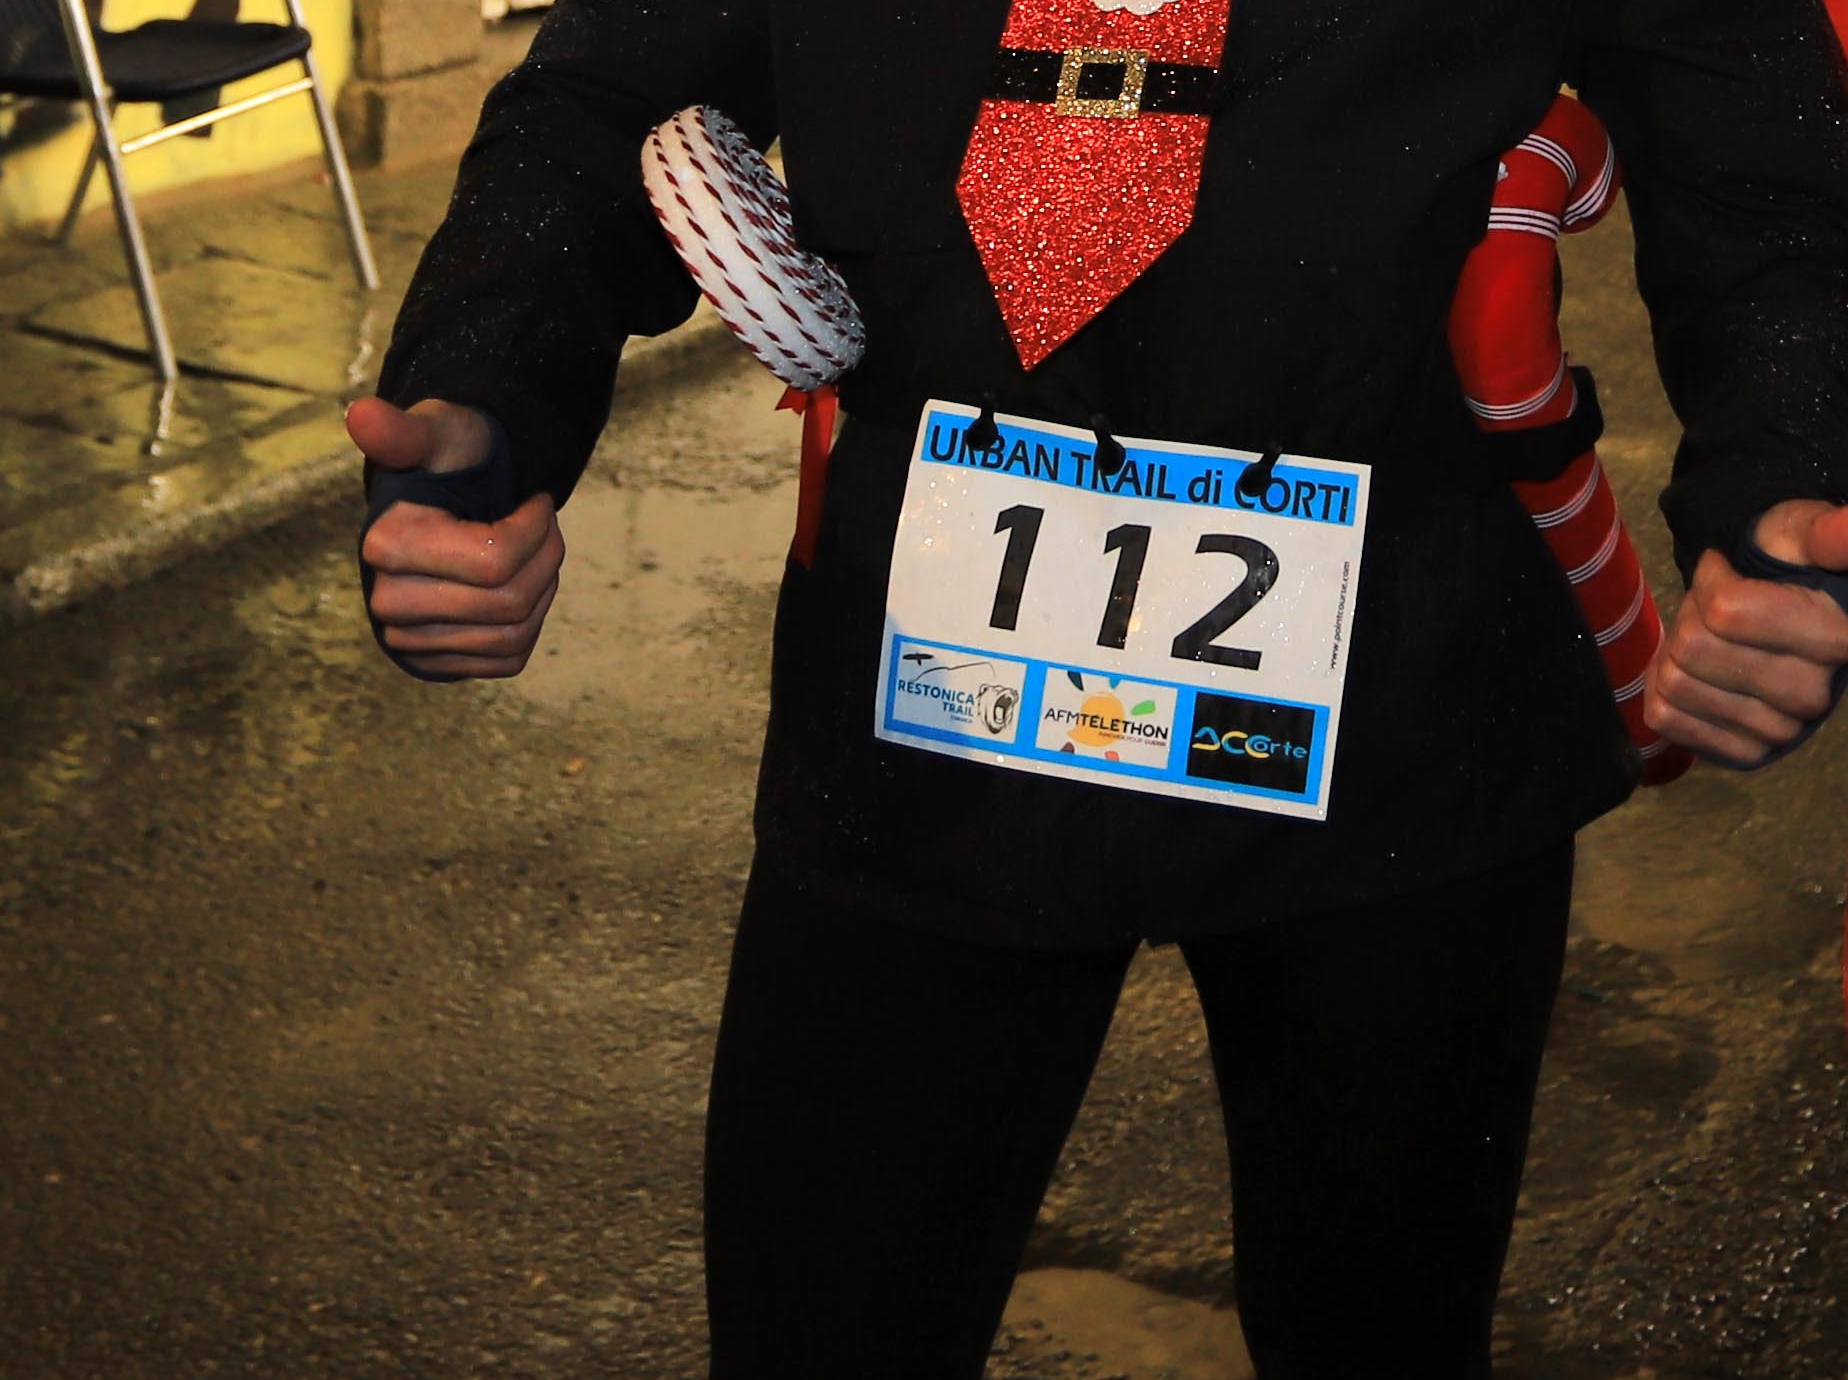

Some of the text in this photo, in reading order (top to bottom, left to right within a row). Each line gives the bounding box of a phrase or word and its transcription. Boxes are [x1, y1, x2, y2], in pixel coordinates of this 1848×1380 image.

[930, 424, 1060, 482] URBAN
[1188, 469, 1223, 505] di
[987, 503, 1281, 672] 112
[1330, 560, 1351, 672] www.pointcourse.com
[898, 680, 976, 707] RESTONICA
[942, 701, 975, 718] TRAIL
